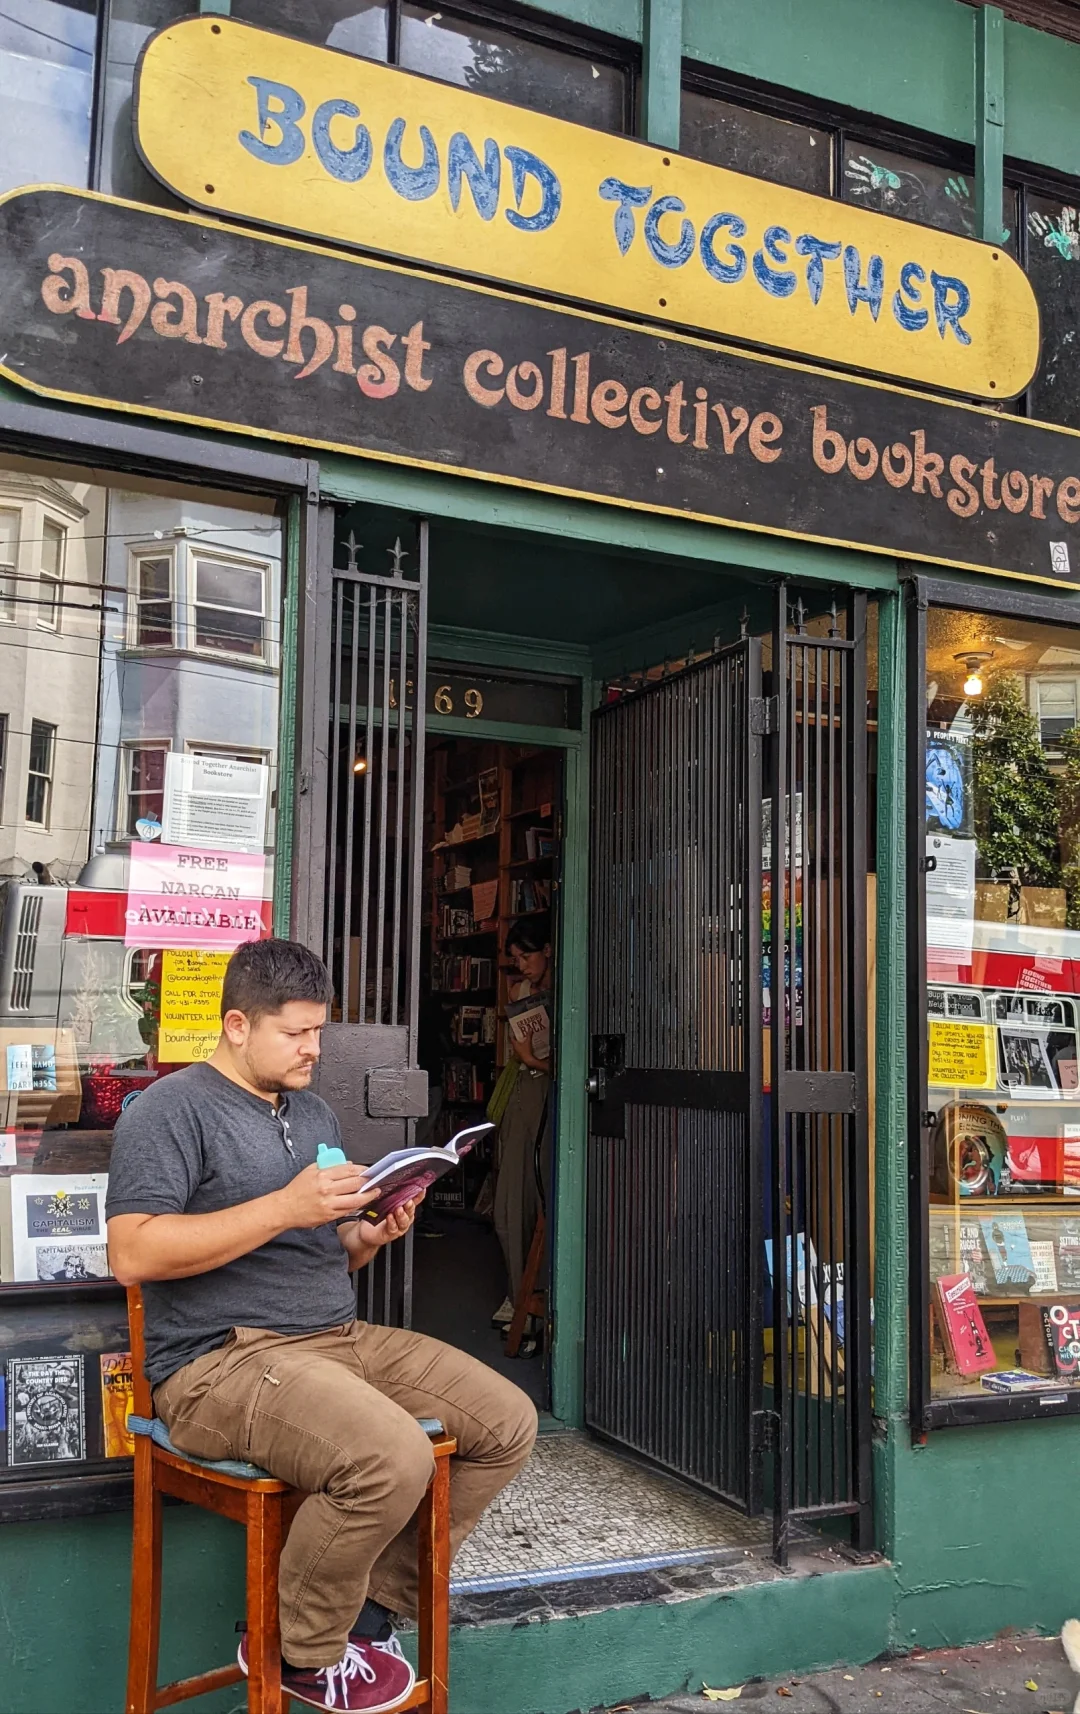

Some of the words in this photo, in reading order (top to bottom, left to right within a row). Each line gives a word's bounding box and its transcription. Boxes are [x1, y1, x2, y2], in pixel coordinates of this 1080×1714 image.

[241, 76, 561, 232] BOUND
[600, 177, 971, 344] TOGETHER
[41, 252, 433, 400] anarchist
[463, 346, 785, 464] collective
[809, 404, 1080, 524] bookstore
[180, 757, 200, 766] Bnd
[201, 760, 229, 769] Together
[228, 764, 257, 773] Anarchist
[203, 768, 233, 778] Bookstore
[176, 854, 229, 872] FREE
[160, 880, 241, 901] NARCAN
[139, 907, 256, 930] AVAILABLE
[182, 990, 197, 998] FOR
[199, 990, 221, 999] STORE
[164, 1012, 205, 1021] VOLUNTEER
[165, 1032, 219, 1047] boundtogethe
[24, 1050, 39, 1059] TE
[32, 1218, 95, 1228] CAPITALISM
[26, 1377, 53, 1385] COUNTRY
[54, 1376, 68, 1384] DIED
